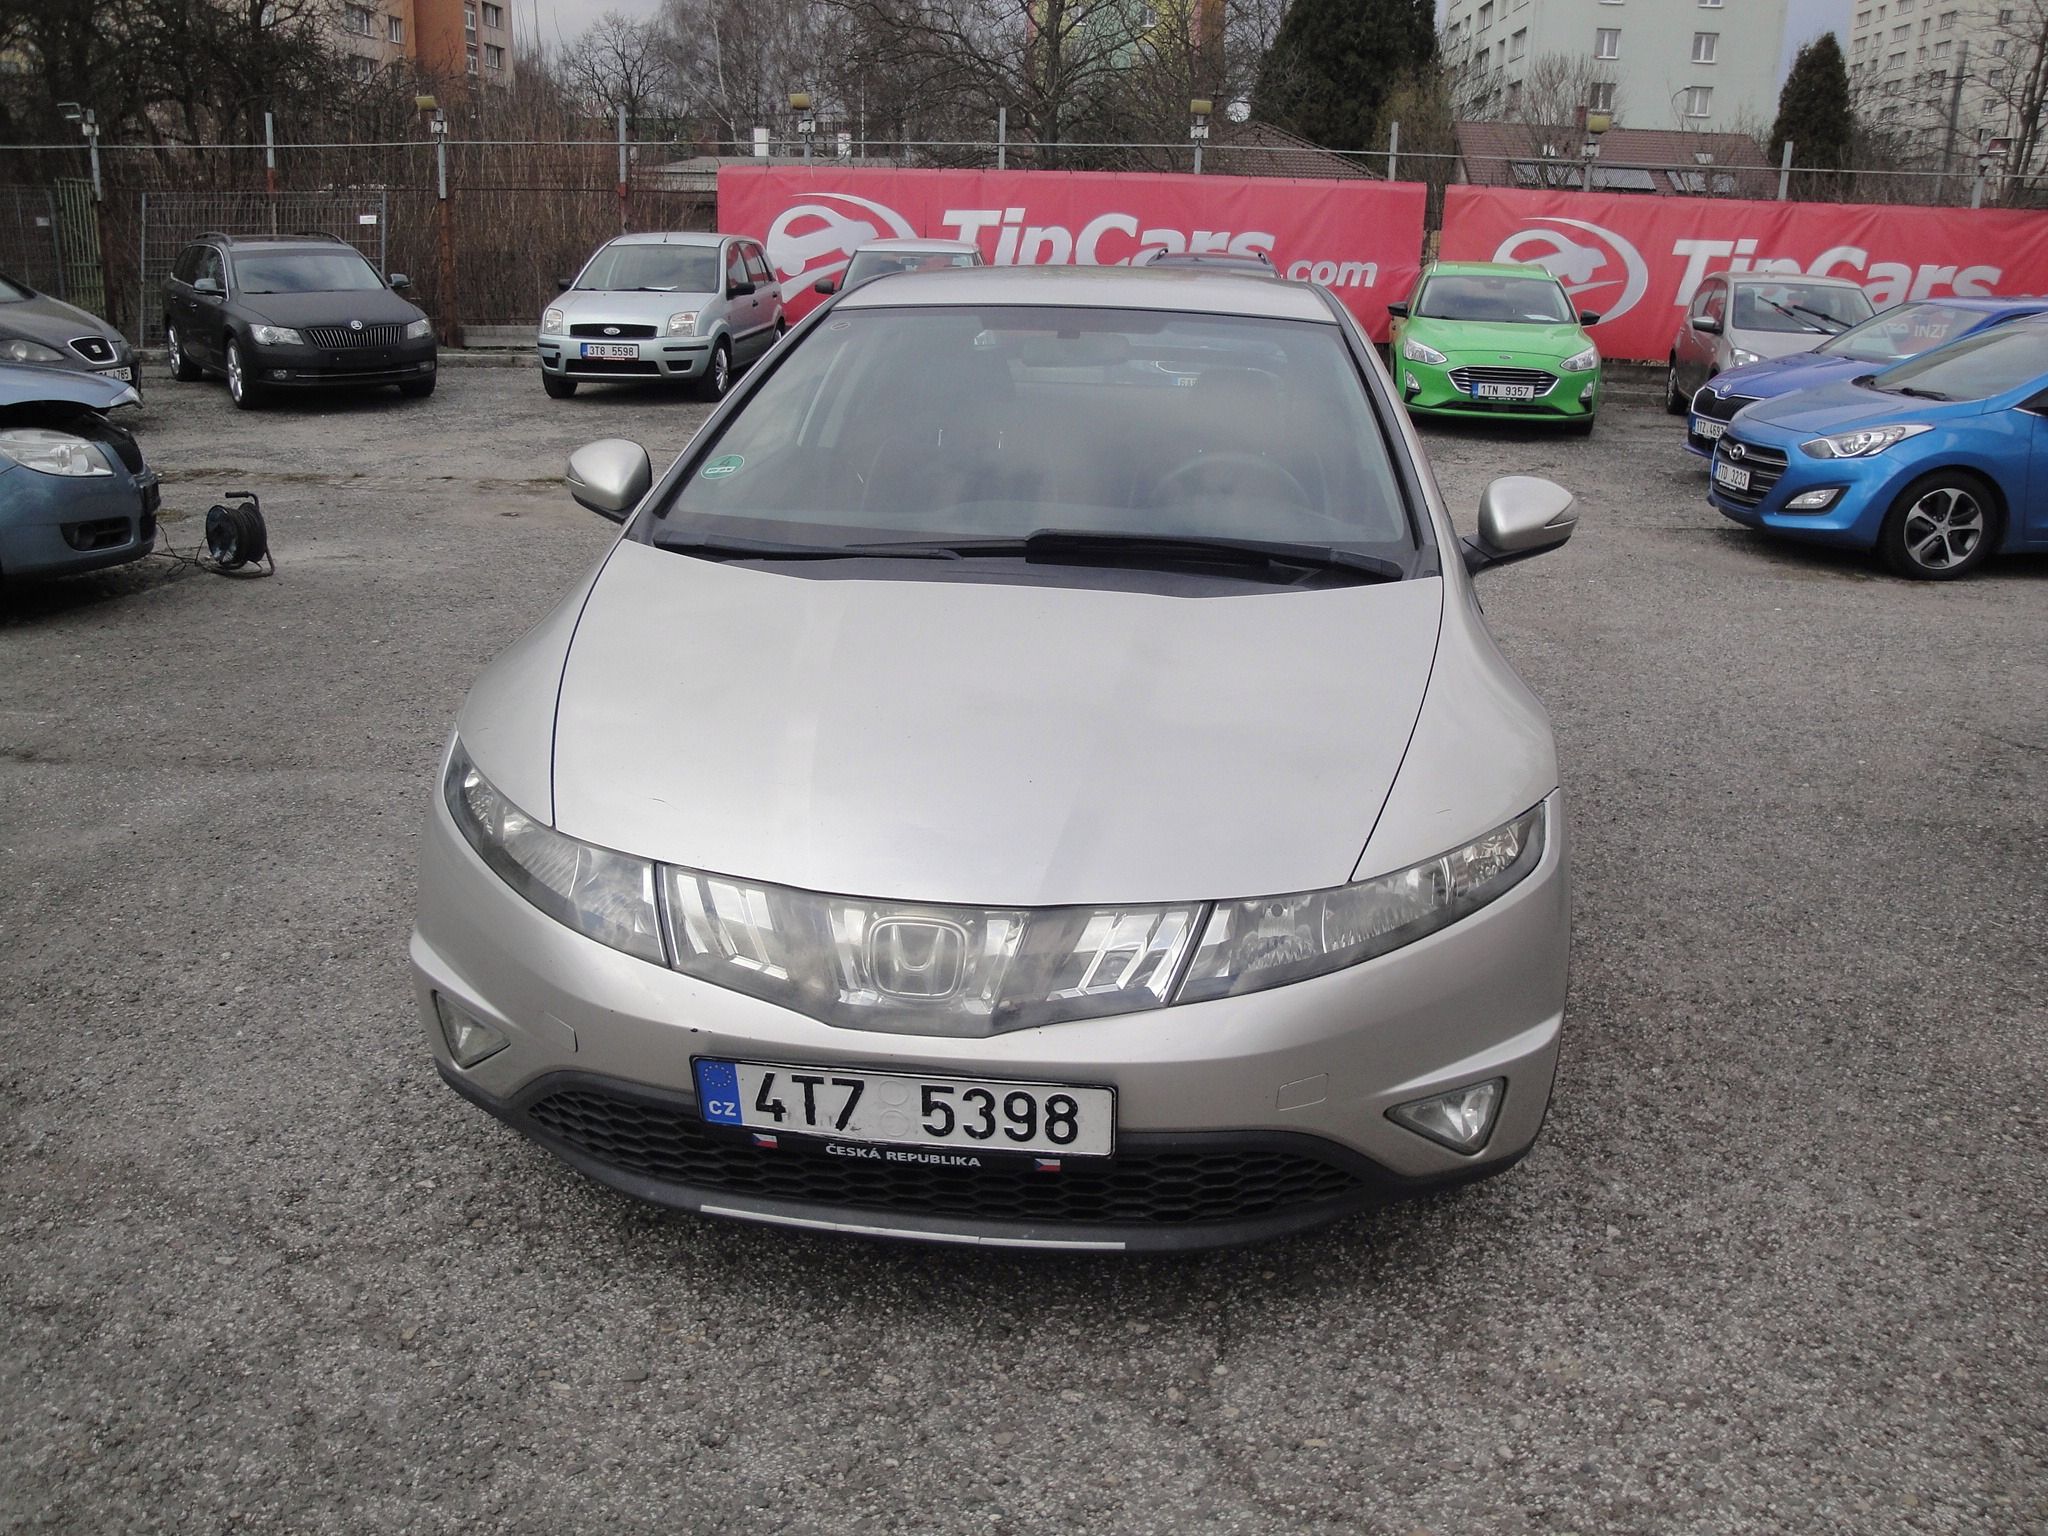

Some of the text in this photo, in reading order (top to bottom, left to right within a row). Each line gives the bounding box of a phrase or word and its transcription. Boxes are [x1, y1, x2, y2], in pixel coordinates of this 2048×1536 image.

[611, 346, 634, 357] 5598
[1481, 385, 1530, 397] 1TN 9357
[708, 1100, 737, 1117] CZ
[755, 1072, 1079, 1145] 4T7 5398
[825, 1142, 982, 1168] ČESKÁ REPUBLIKA
